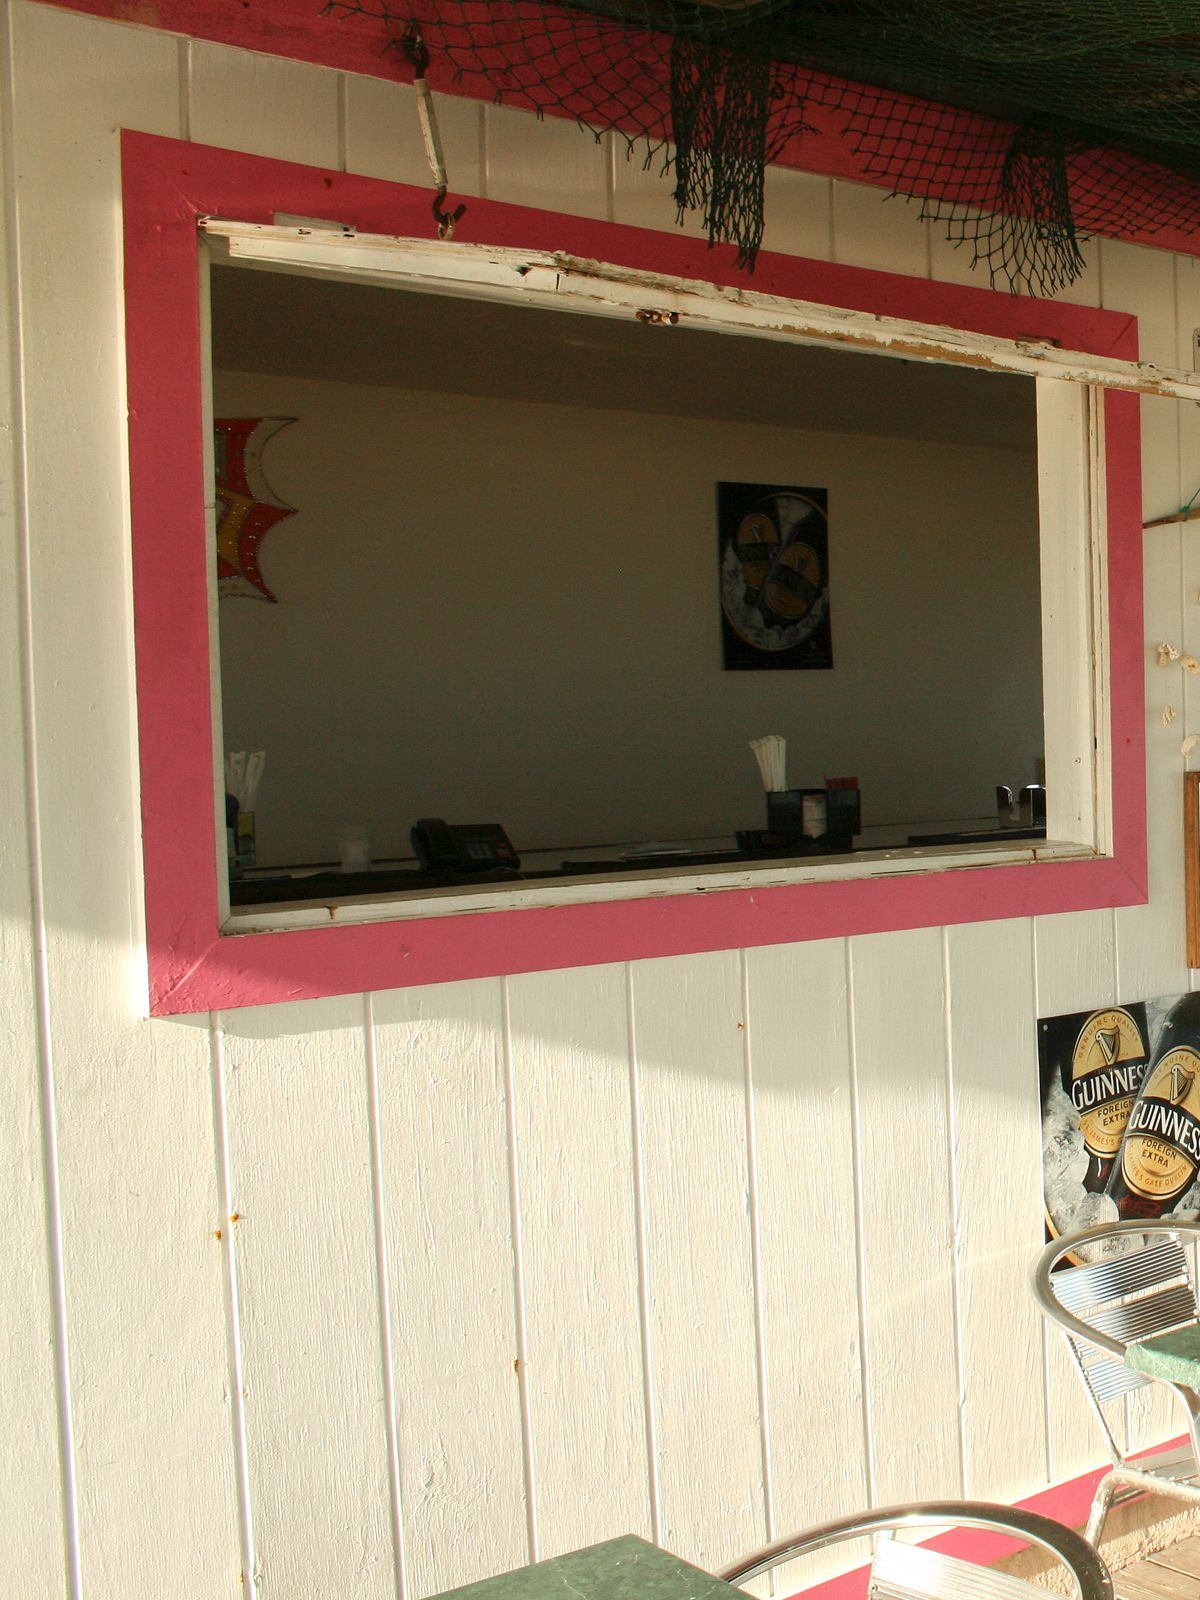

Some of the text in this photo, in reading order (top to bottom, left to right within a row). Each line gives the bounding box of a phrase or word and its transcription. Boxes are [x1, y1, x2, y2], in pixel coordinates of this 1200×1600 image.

[1097, 1099, 1134, 1118] FOREIGN
[1102, 1111, 1131, 1127] EXTRA
[1141, 1138, 1178, 1160] FOREIGN
[1141, 1149, 1169, 1168] EXTRA
[1145, 1176, 1163, 1188] GATE
